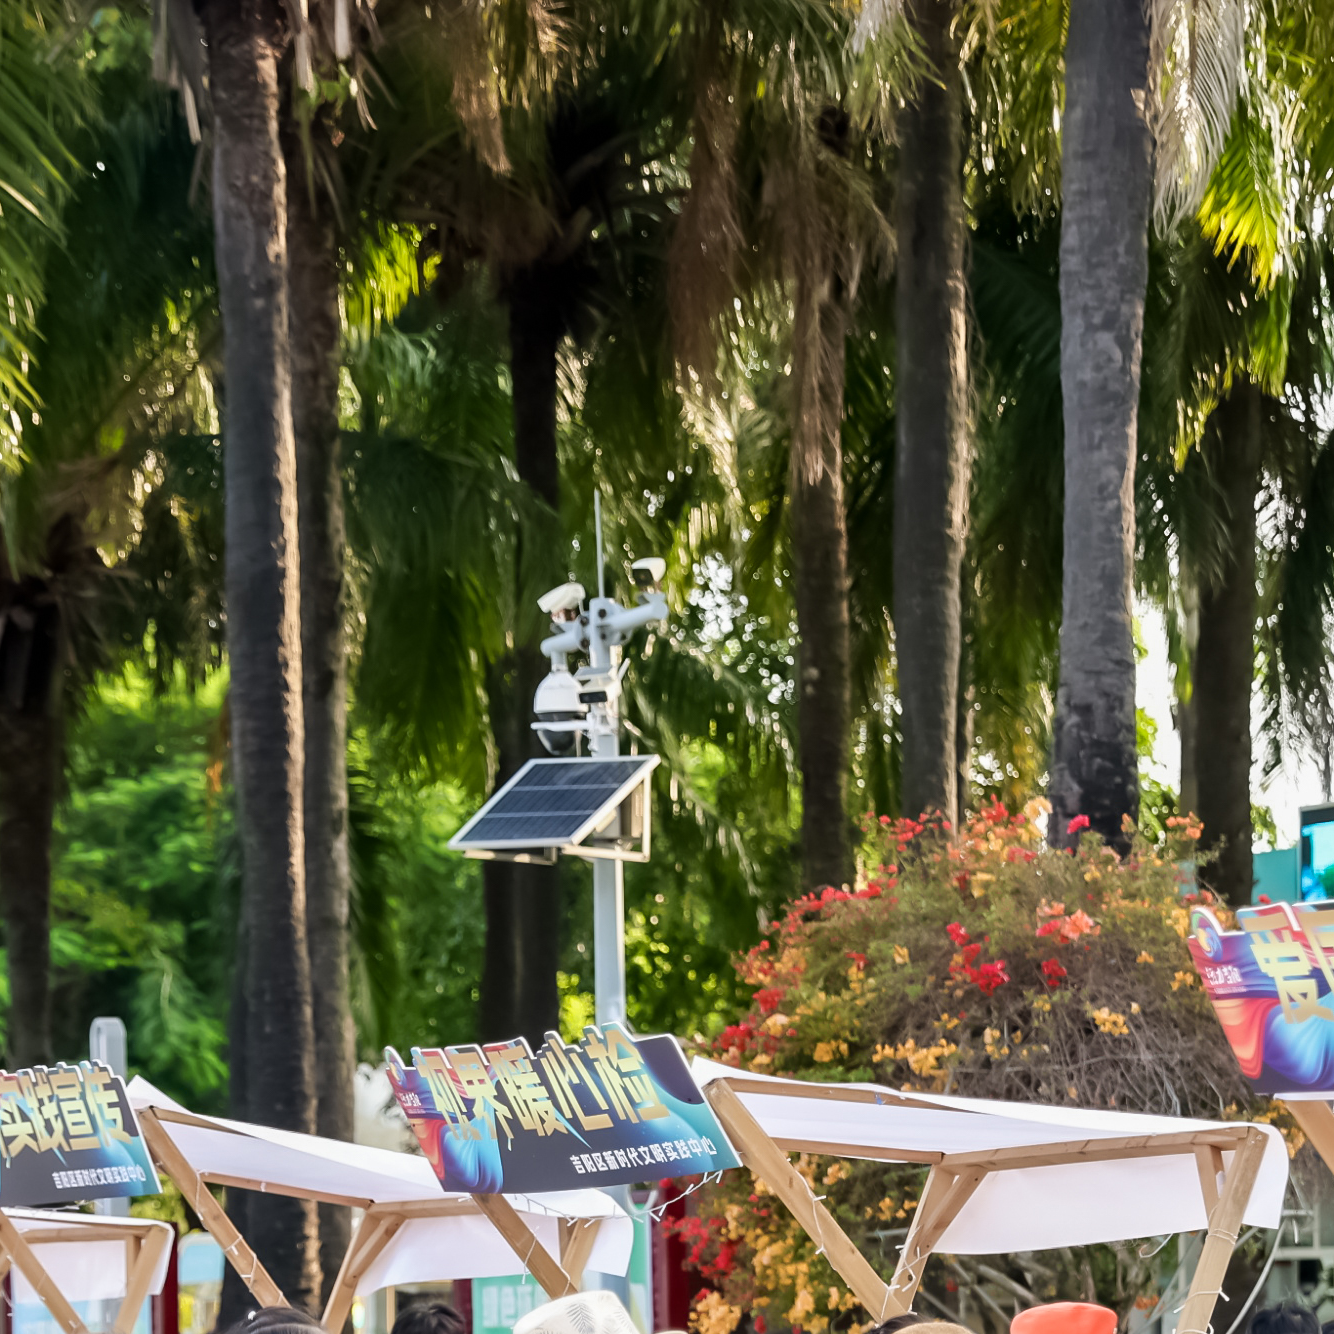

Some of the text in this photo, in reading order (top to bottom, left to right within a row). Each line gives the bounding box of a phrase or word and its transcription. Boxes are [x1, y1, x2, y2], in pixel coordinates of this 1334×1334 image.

[569, 1136, 717, 1175] 吉阳区新时代文明实践中心
